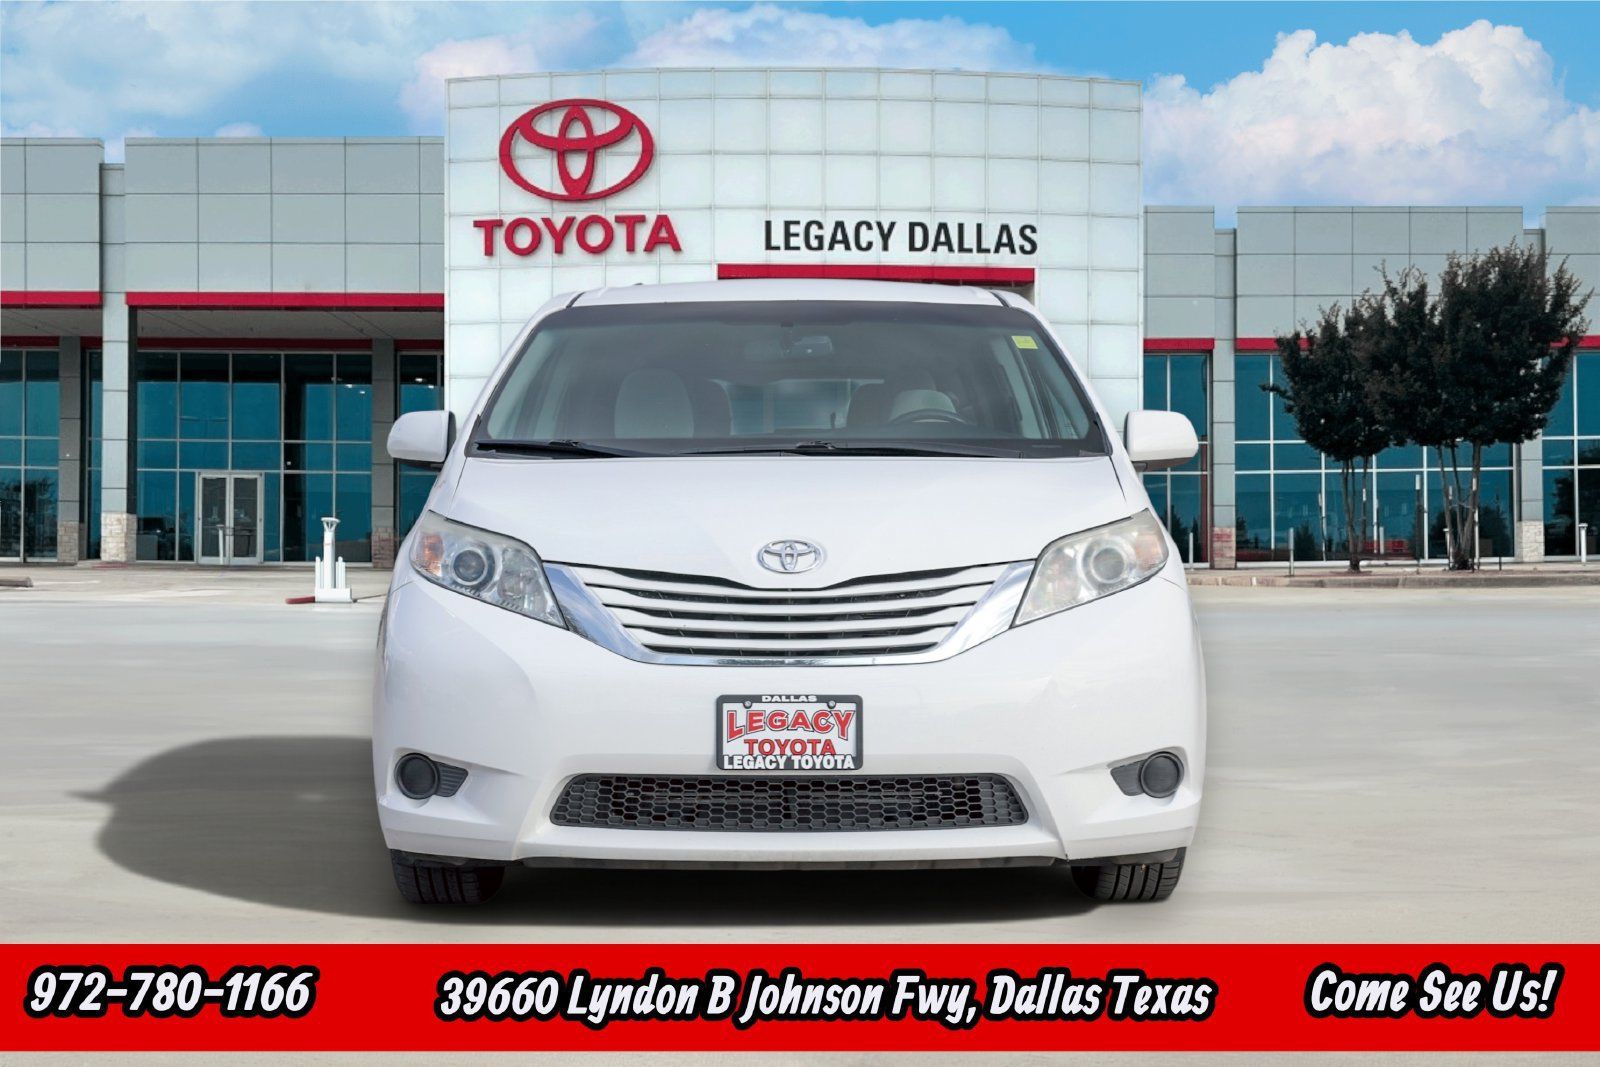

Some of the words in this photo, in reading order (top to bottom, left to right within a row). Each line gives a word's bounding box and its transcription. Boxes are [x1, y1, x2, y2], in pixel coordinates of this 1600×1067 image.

[473, 214, 683, 257] TOYOTA
[764, 220, 897, 252] LEGACY
[908, 221, 1039, 255] DALLAS
[761, 694, 818, 703] DALLAS
[726, 709, 856, 743] LEGACY
[743, 738, 838, 756] TOYOTA
[723, 754, 788, 770] LEGACY
[791, 754, 856, 770] TOYOTA
